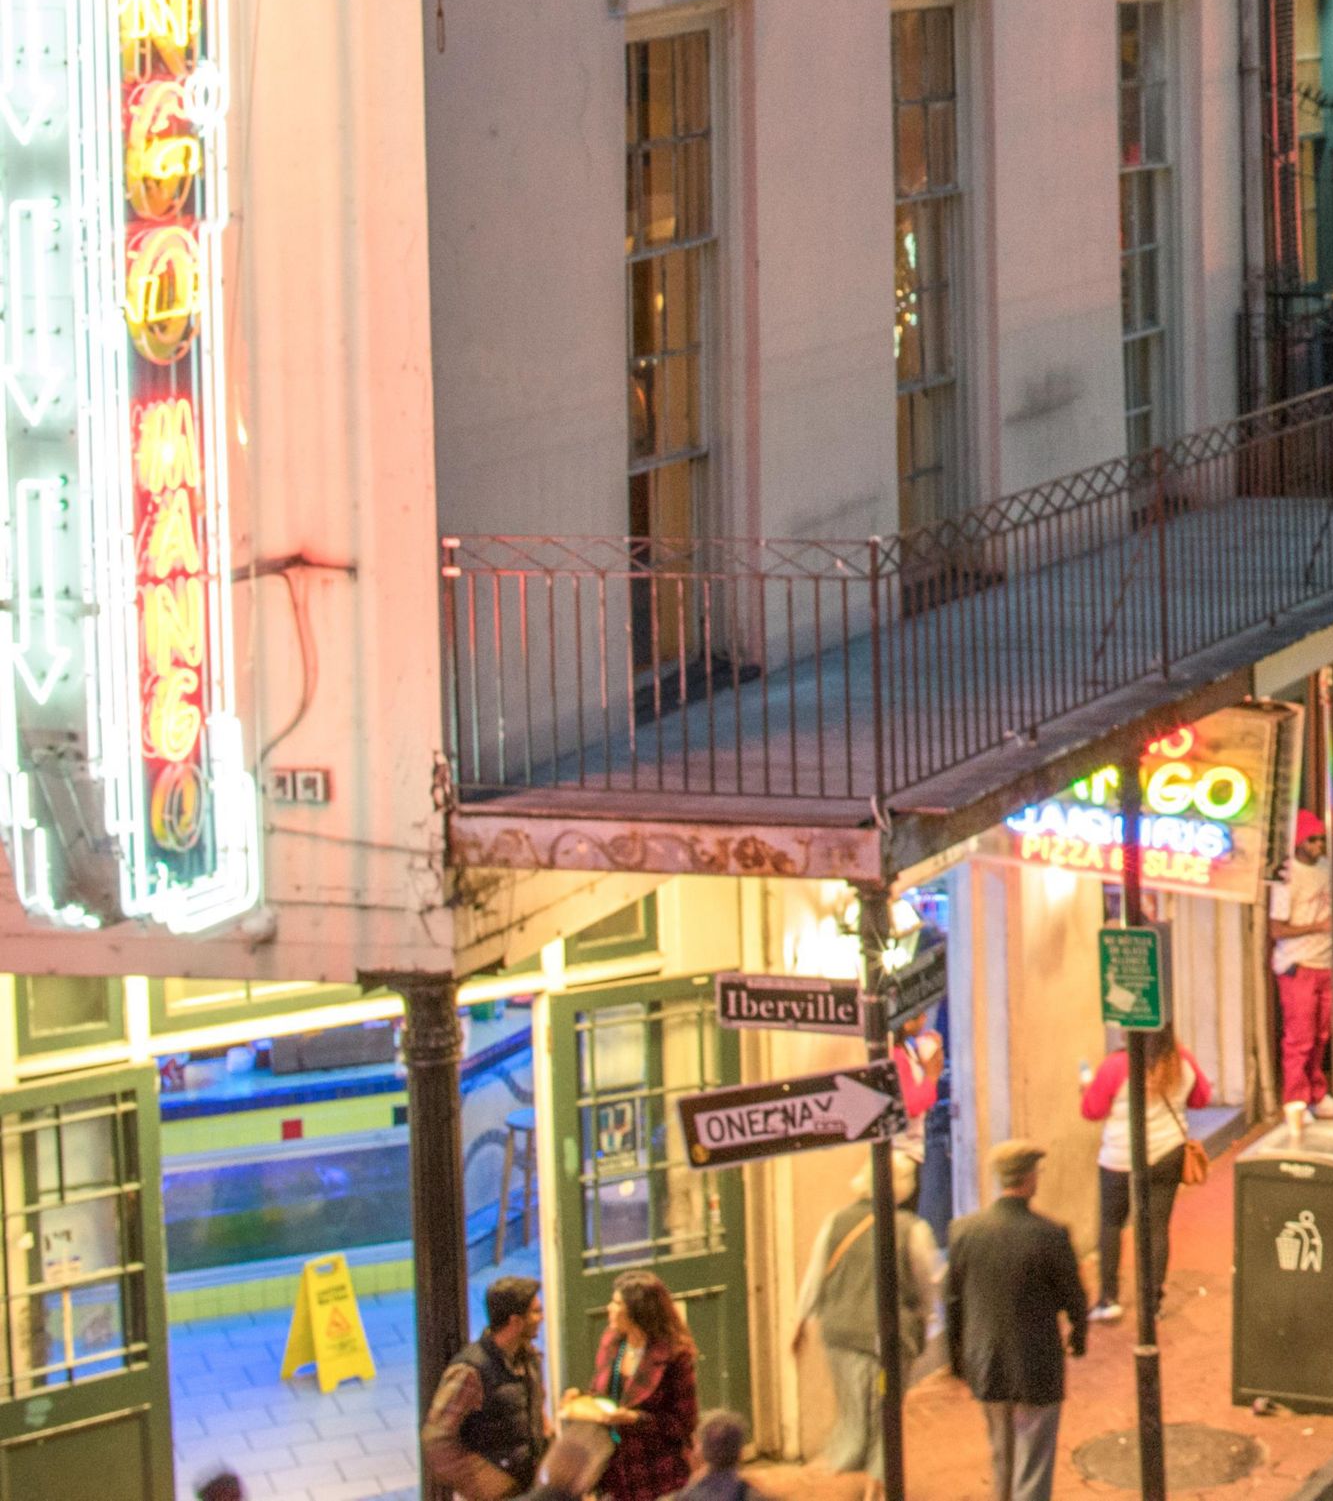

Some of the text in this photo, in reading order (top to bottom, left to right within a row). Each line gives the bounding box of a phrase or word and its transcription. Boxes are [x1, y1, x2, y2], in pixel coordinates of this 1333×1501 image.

[132, 398, 206, 853] MANGO
[1021, 834, 1103, 869] PIZZA
[1144, 849, 1213, 884] SLICE
[726, 990, 855, 1022] Iberville
[705, 1109, 764, 1143] ONE
